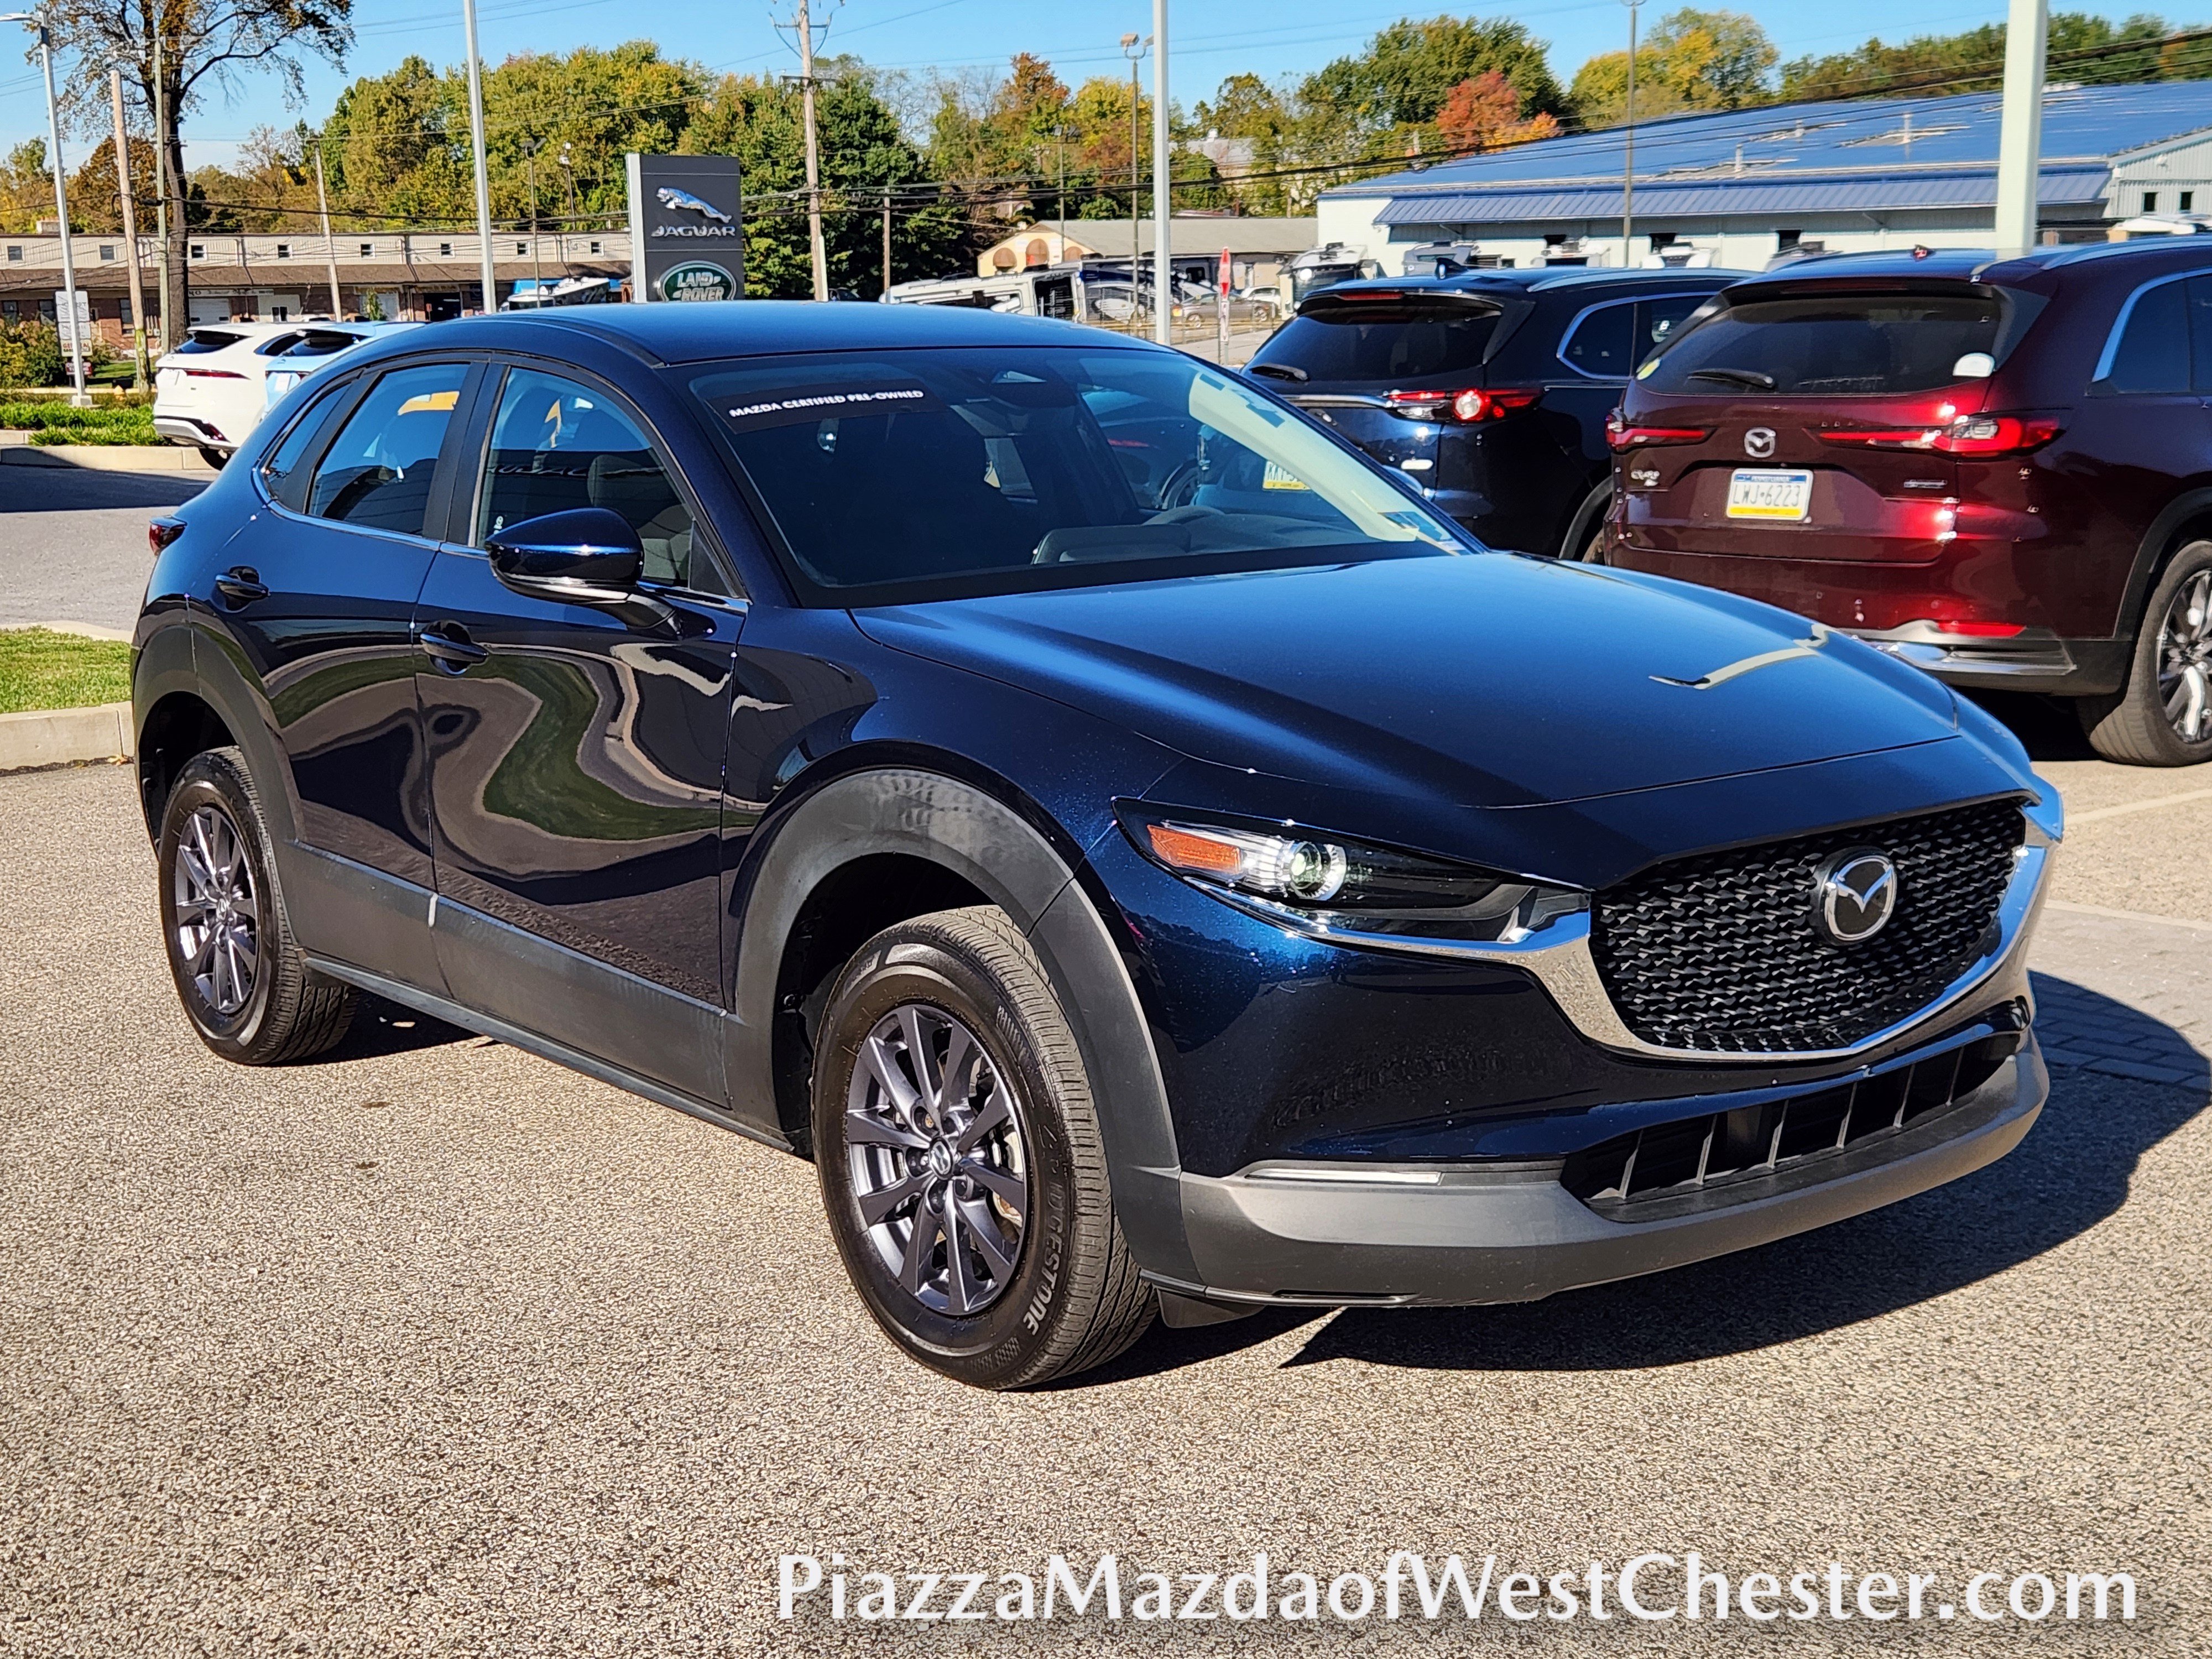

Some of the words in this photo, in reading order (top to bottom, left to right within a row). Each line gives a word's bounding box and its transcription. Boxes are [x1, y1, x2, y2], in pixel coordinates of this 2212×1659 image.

[651, 226, 735, 237] JAGUAR
[677, 272, 713, 288] LAND
[680, 286, 724, 301] ROVER
[729, 403, 782, 418] MAZDA
[781, 394, 847, 409] CERTIFIED
[847, 390, 925, 403] PRE-OWNED
